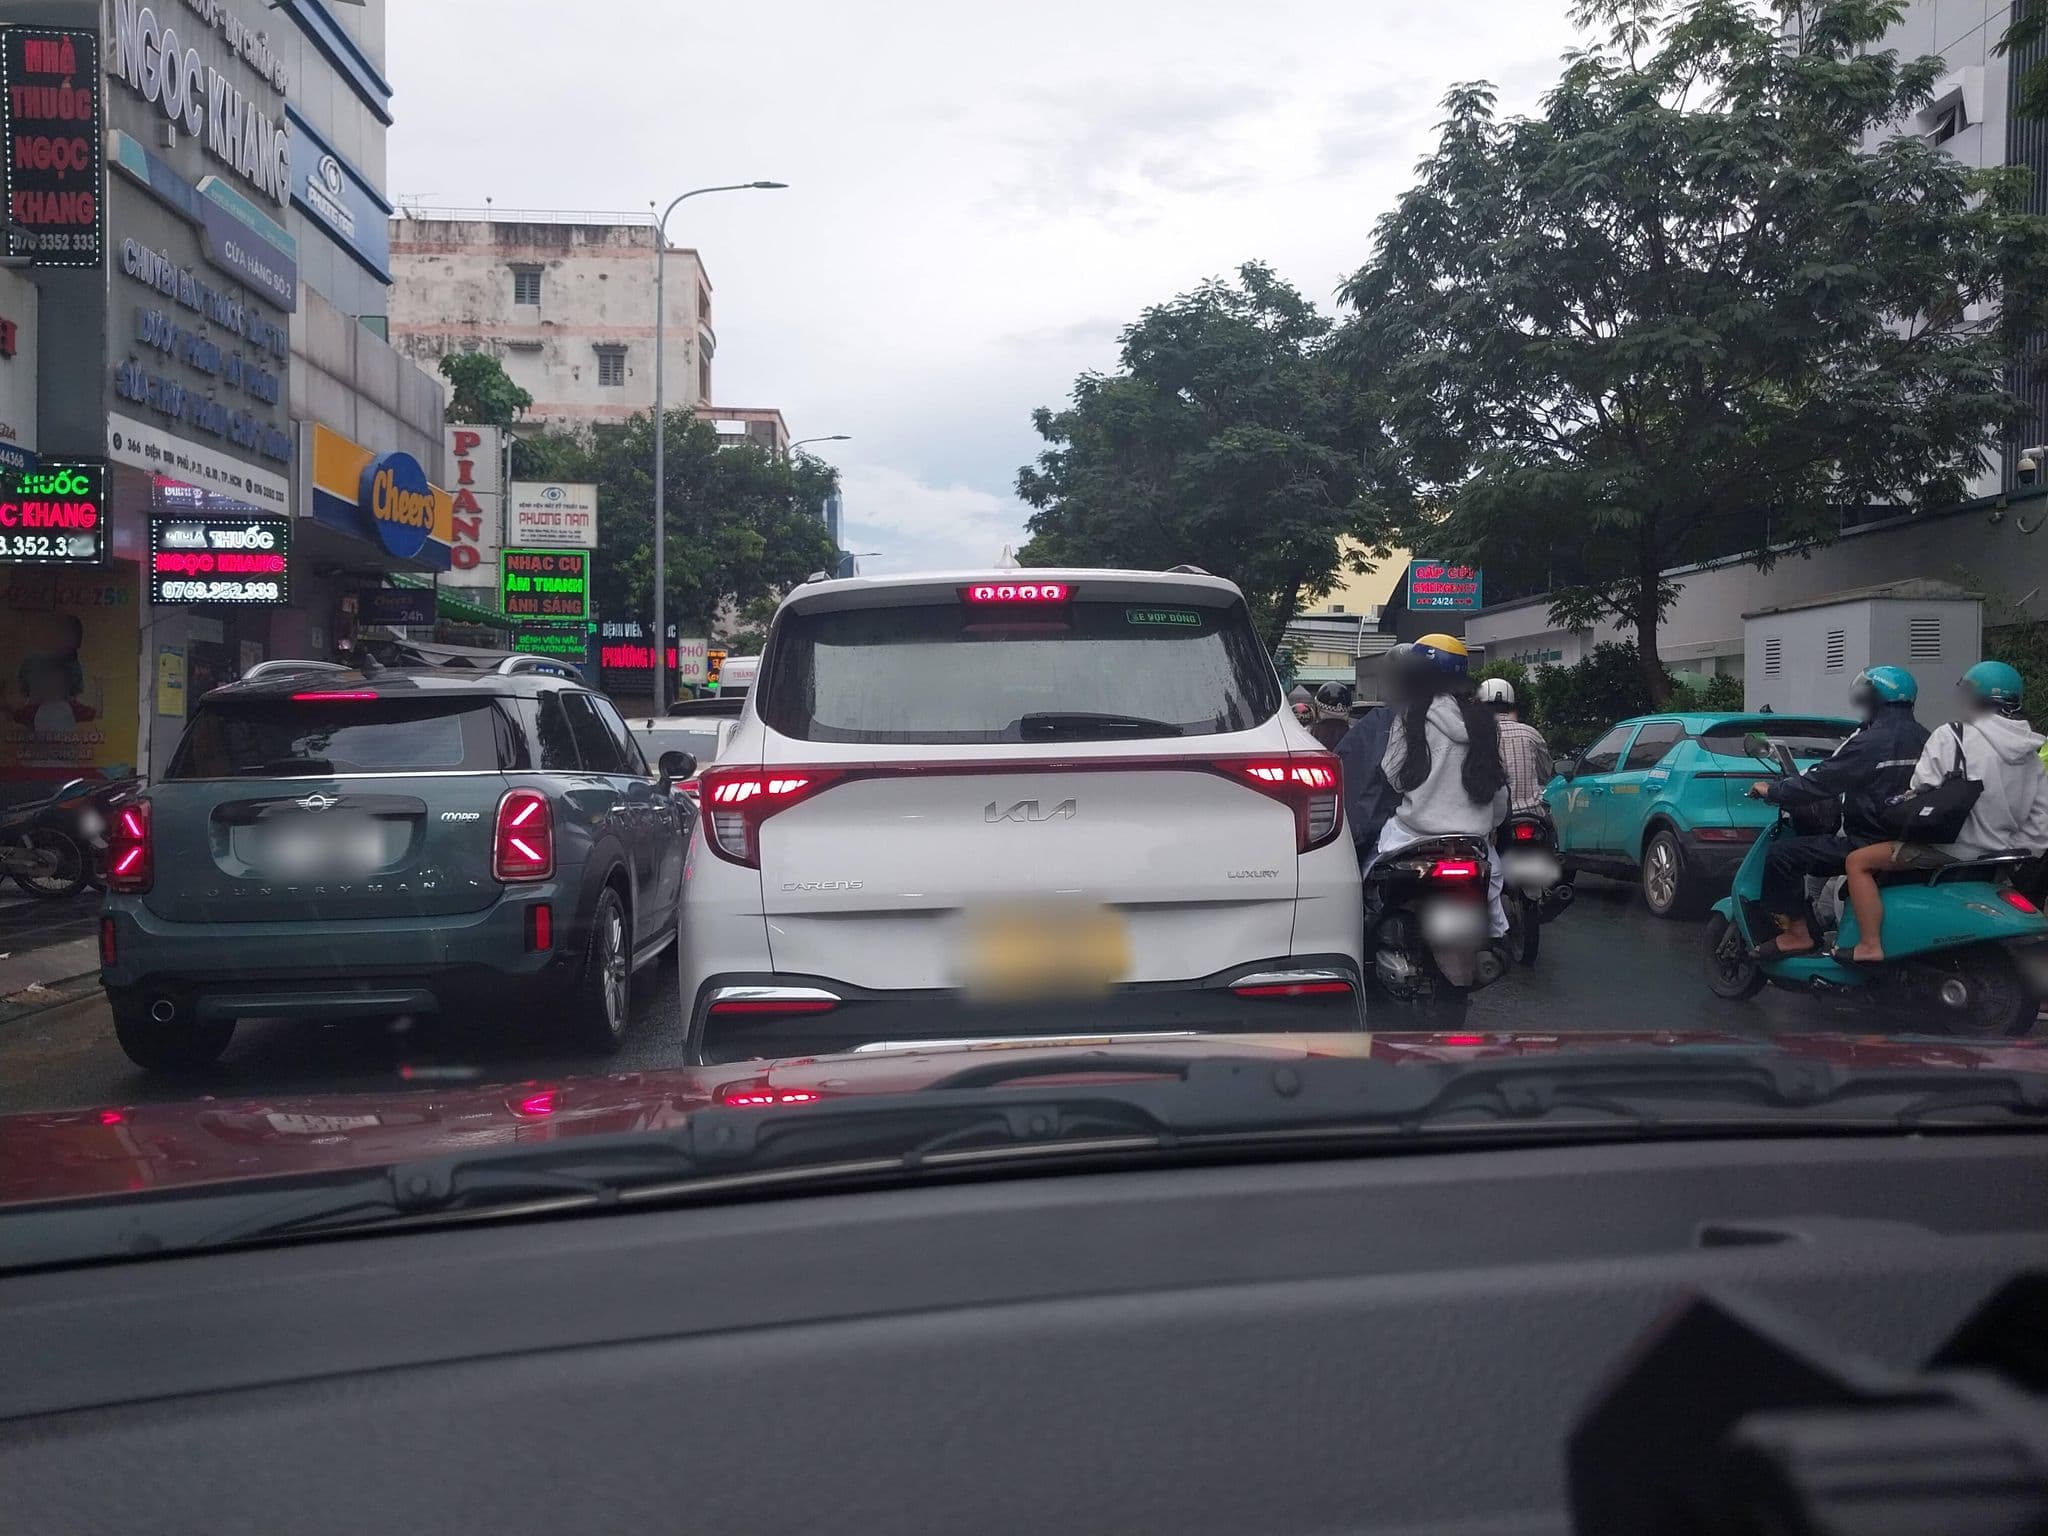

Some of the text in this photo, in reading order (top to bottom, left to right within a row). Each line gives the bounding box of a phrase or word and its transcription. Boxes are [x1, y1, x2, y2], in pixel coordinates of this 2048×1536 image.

[24, 34, 77, 74] NHÀ
[10, 76, 92, 120] THUỐC
[116, 0, 290, 208] NGỌC KHANG
[15, 136, 89, 180] NGỌC
[12, 191, 95, 224] KHANG
[39, 234, 70, 250] 3352
[73, 234, 95, 250] 333
[286, 283, 292, 300] 2
[127, 438, 141, 454] 366
[372, 467, 436, 531] Cheers
[451, 430, 483, 570] PIANO
[22, 501, 98, 529] KHANG
[564, 512, 590, 527] NAM
[208, 524, 275, 550] THUỐC
[156, 553, 284, 577] NGỌC KHANG
[506, 555, 582, 574] NHẠC CỤ
[162, 580, 279, 600] 0763.352.333
[506, 573, 583, 593] ÂM THANH
[508, 595, 582, 614] ÁNH SÁNG
[1431, 597, 1454, 606] 24/24
[400, 610, 424, 622] 24h
[680, 642, 704, 658] PHỞ
[683, 660, 700, 675] BÒ
[440, 811, 481, 824] COOPER
[984, 798, 1077, 823] KIA
[1225, 869, 1280, 880] LUXURY
[780, 879, 864, 892] CARENS
